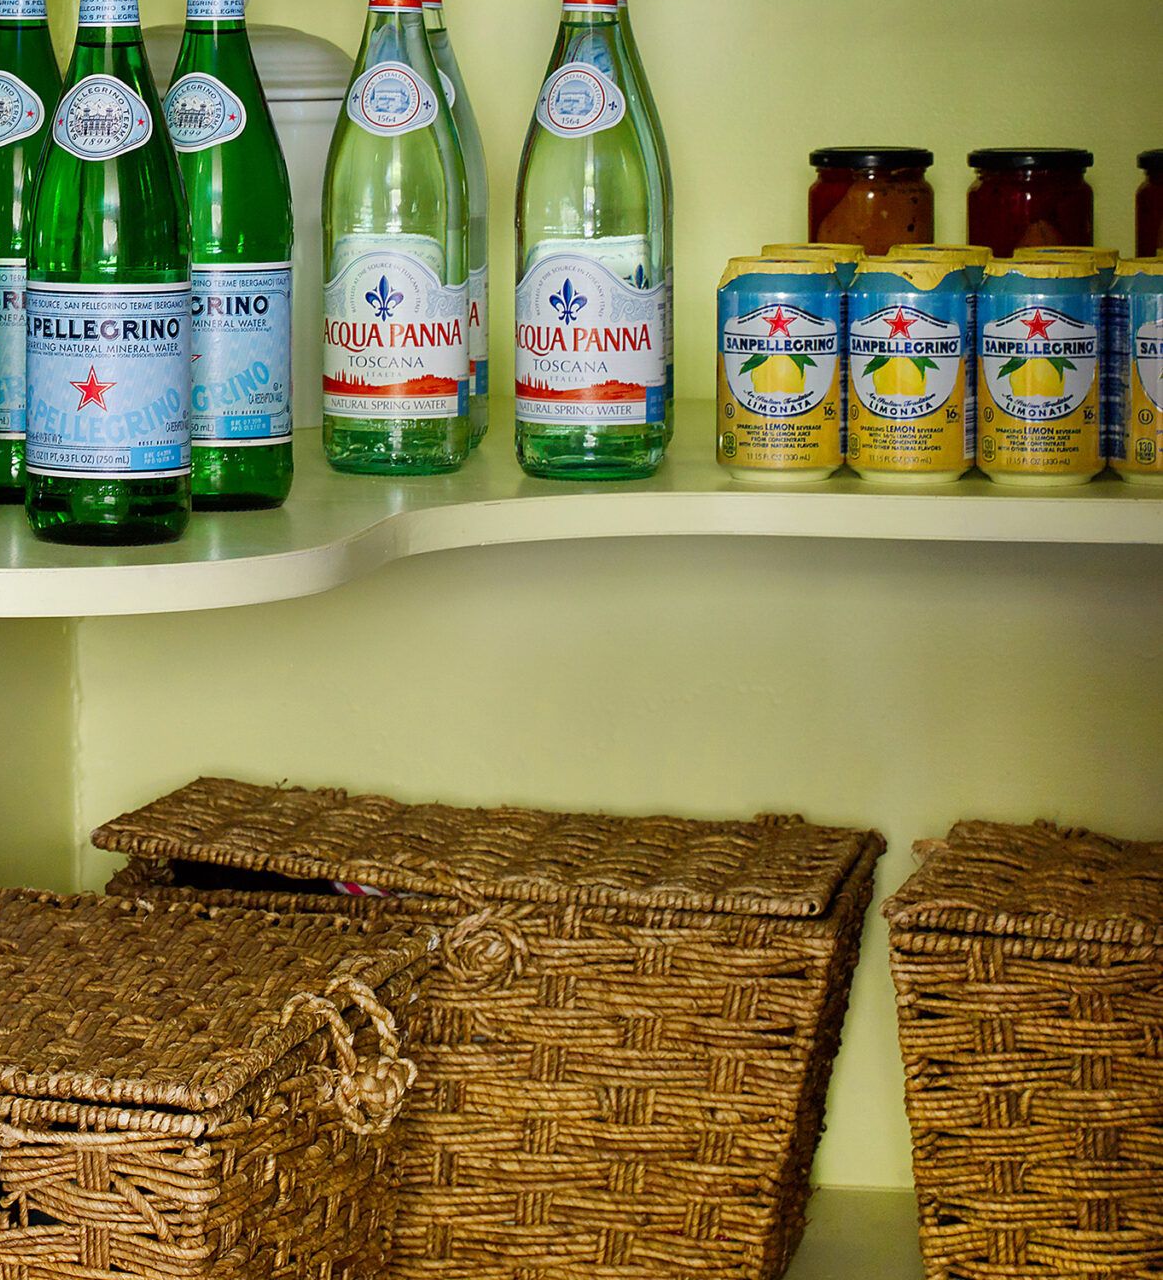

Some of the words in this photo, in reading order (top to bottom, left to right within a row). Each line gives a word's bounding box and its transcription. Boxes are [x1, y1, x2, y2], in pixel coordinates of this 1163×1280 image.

[70, 86, 125, 115] PELLEGRINO
[69, 119, 78, 142] SAN
[113, 109, 130, 143] TERME
[81, 136, 111, 147] 1899
[323, 318, 384, 353] ACQUA
[389, 319, 462, 348] PANNA
[726, 336, 835, 352] SANPELLEGRINO
[851, 340, 959, 355] SANPELLEGRINO
[348, 355, 425, 368] TOSCANA
[331, 398, 369, 410] NATURAL
[371, 399, 411, 410] SPRING
[414, 399, 447, 410] WATER
[747, 399, 812, 413] LIMONATA
[869, 400, 934, 416] LIMONATA
